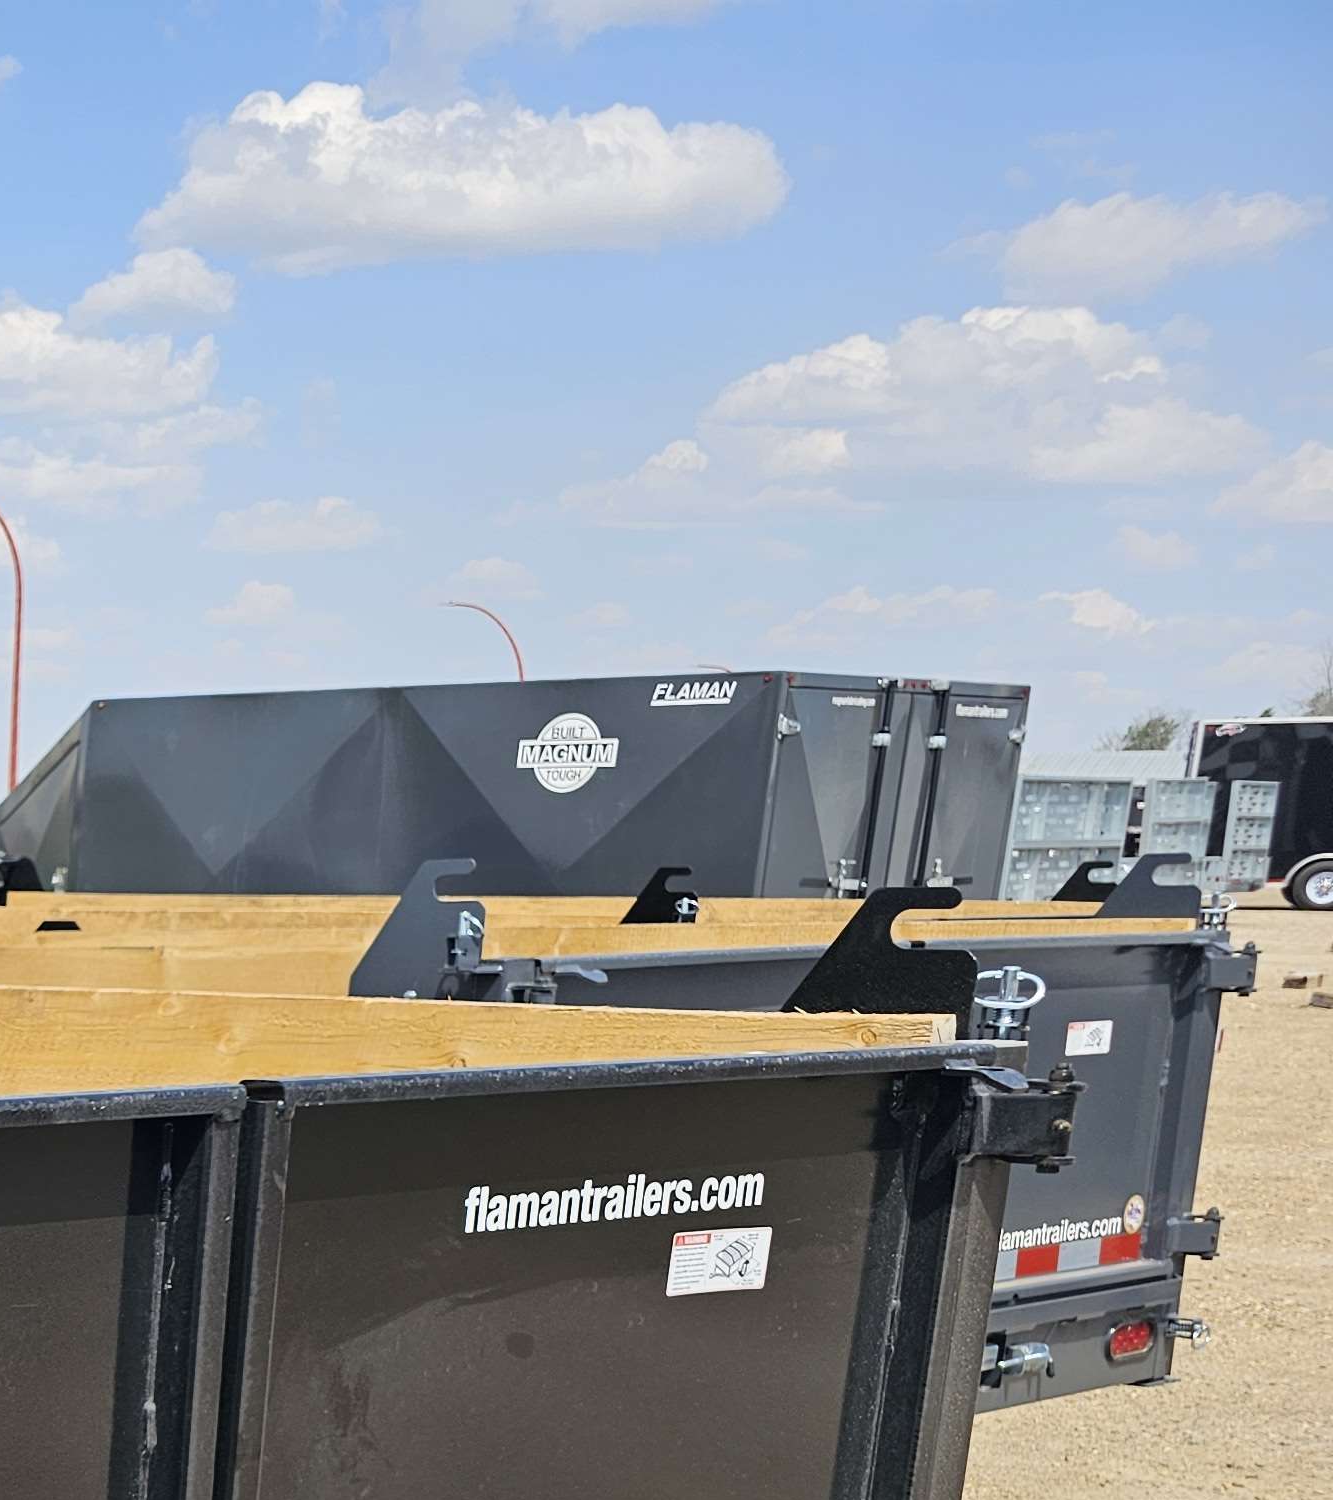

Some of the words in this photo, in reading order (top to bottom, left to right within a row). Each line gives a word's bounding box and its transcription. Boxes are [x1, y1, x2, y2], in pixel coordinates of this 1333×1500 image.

[652, 681, 737, 701] FLAMAN
[552, 727, 587, 739] BUILT
[522, 743, 613, 763] MAGNUM
[546, 770, 581, 781] TOUGH
[464, 1172, 764, 1234] flamantrailers.com
[998, 1215, 1122, 1252] lamantrailers.com
